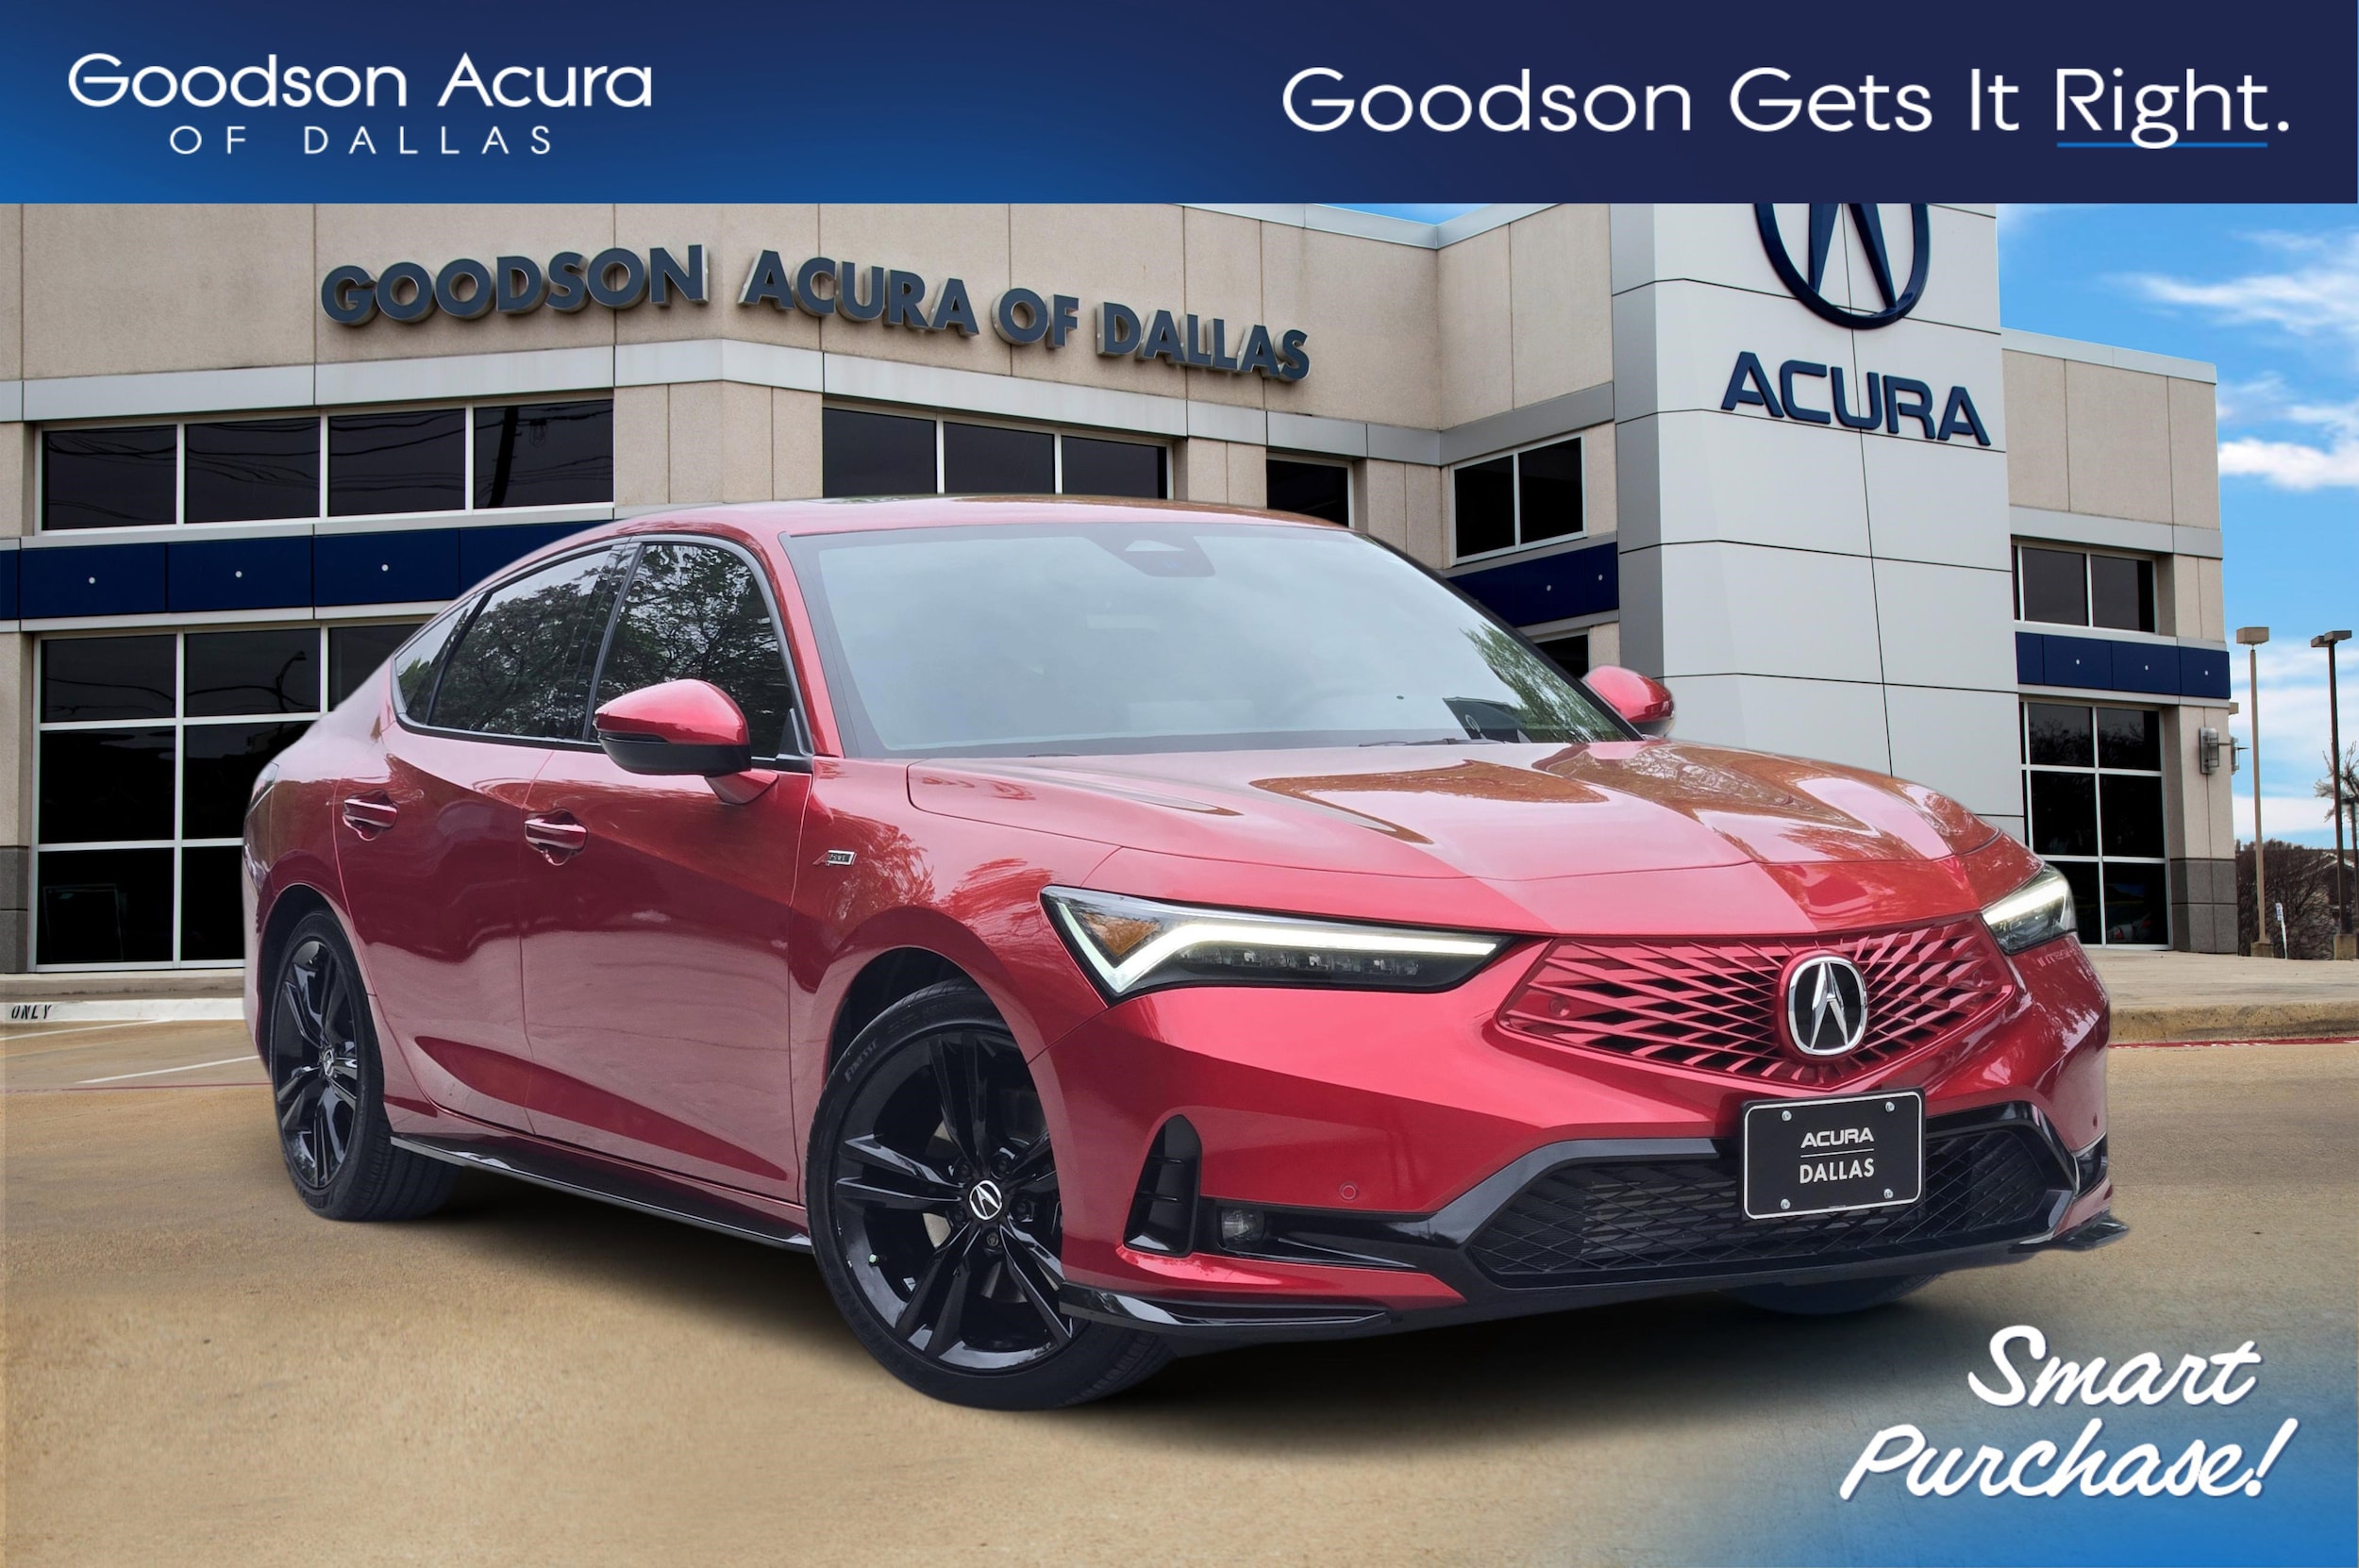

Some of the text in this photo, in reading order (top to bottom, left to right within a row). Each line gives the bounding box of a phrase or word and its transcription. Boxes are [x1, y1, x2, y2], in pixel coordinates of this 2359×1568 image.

[321, 244, 1311, 382] GOODSON ACURA OF DALLAS
[1720, 351, 1991, 446] ACURA
[11, 1004, 52, 1020] ONLY
[1800, 1127, 1875, 1149] ACURA
[1799, 1158, 1875, 1184] DALLAS
